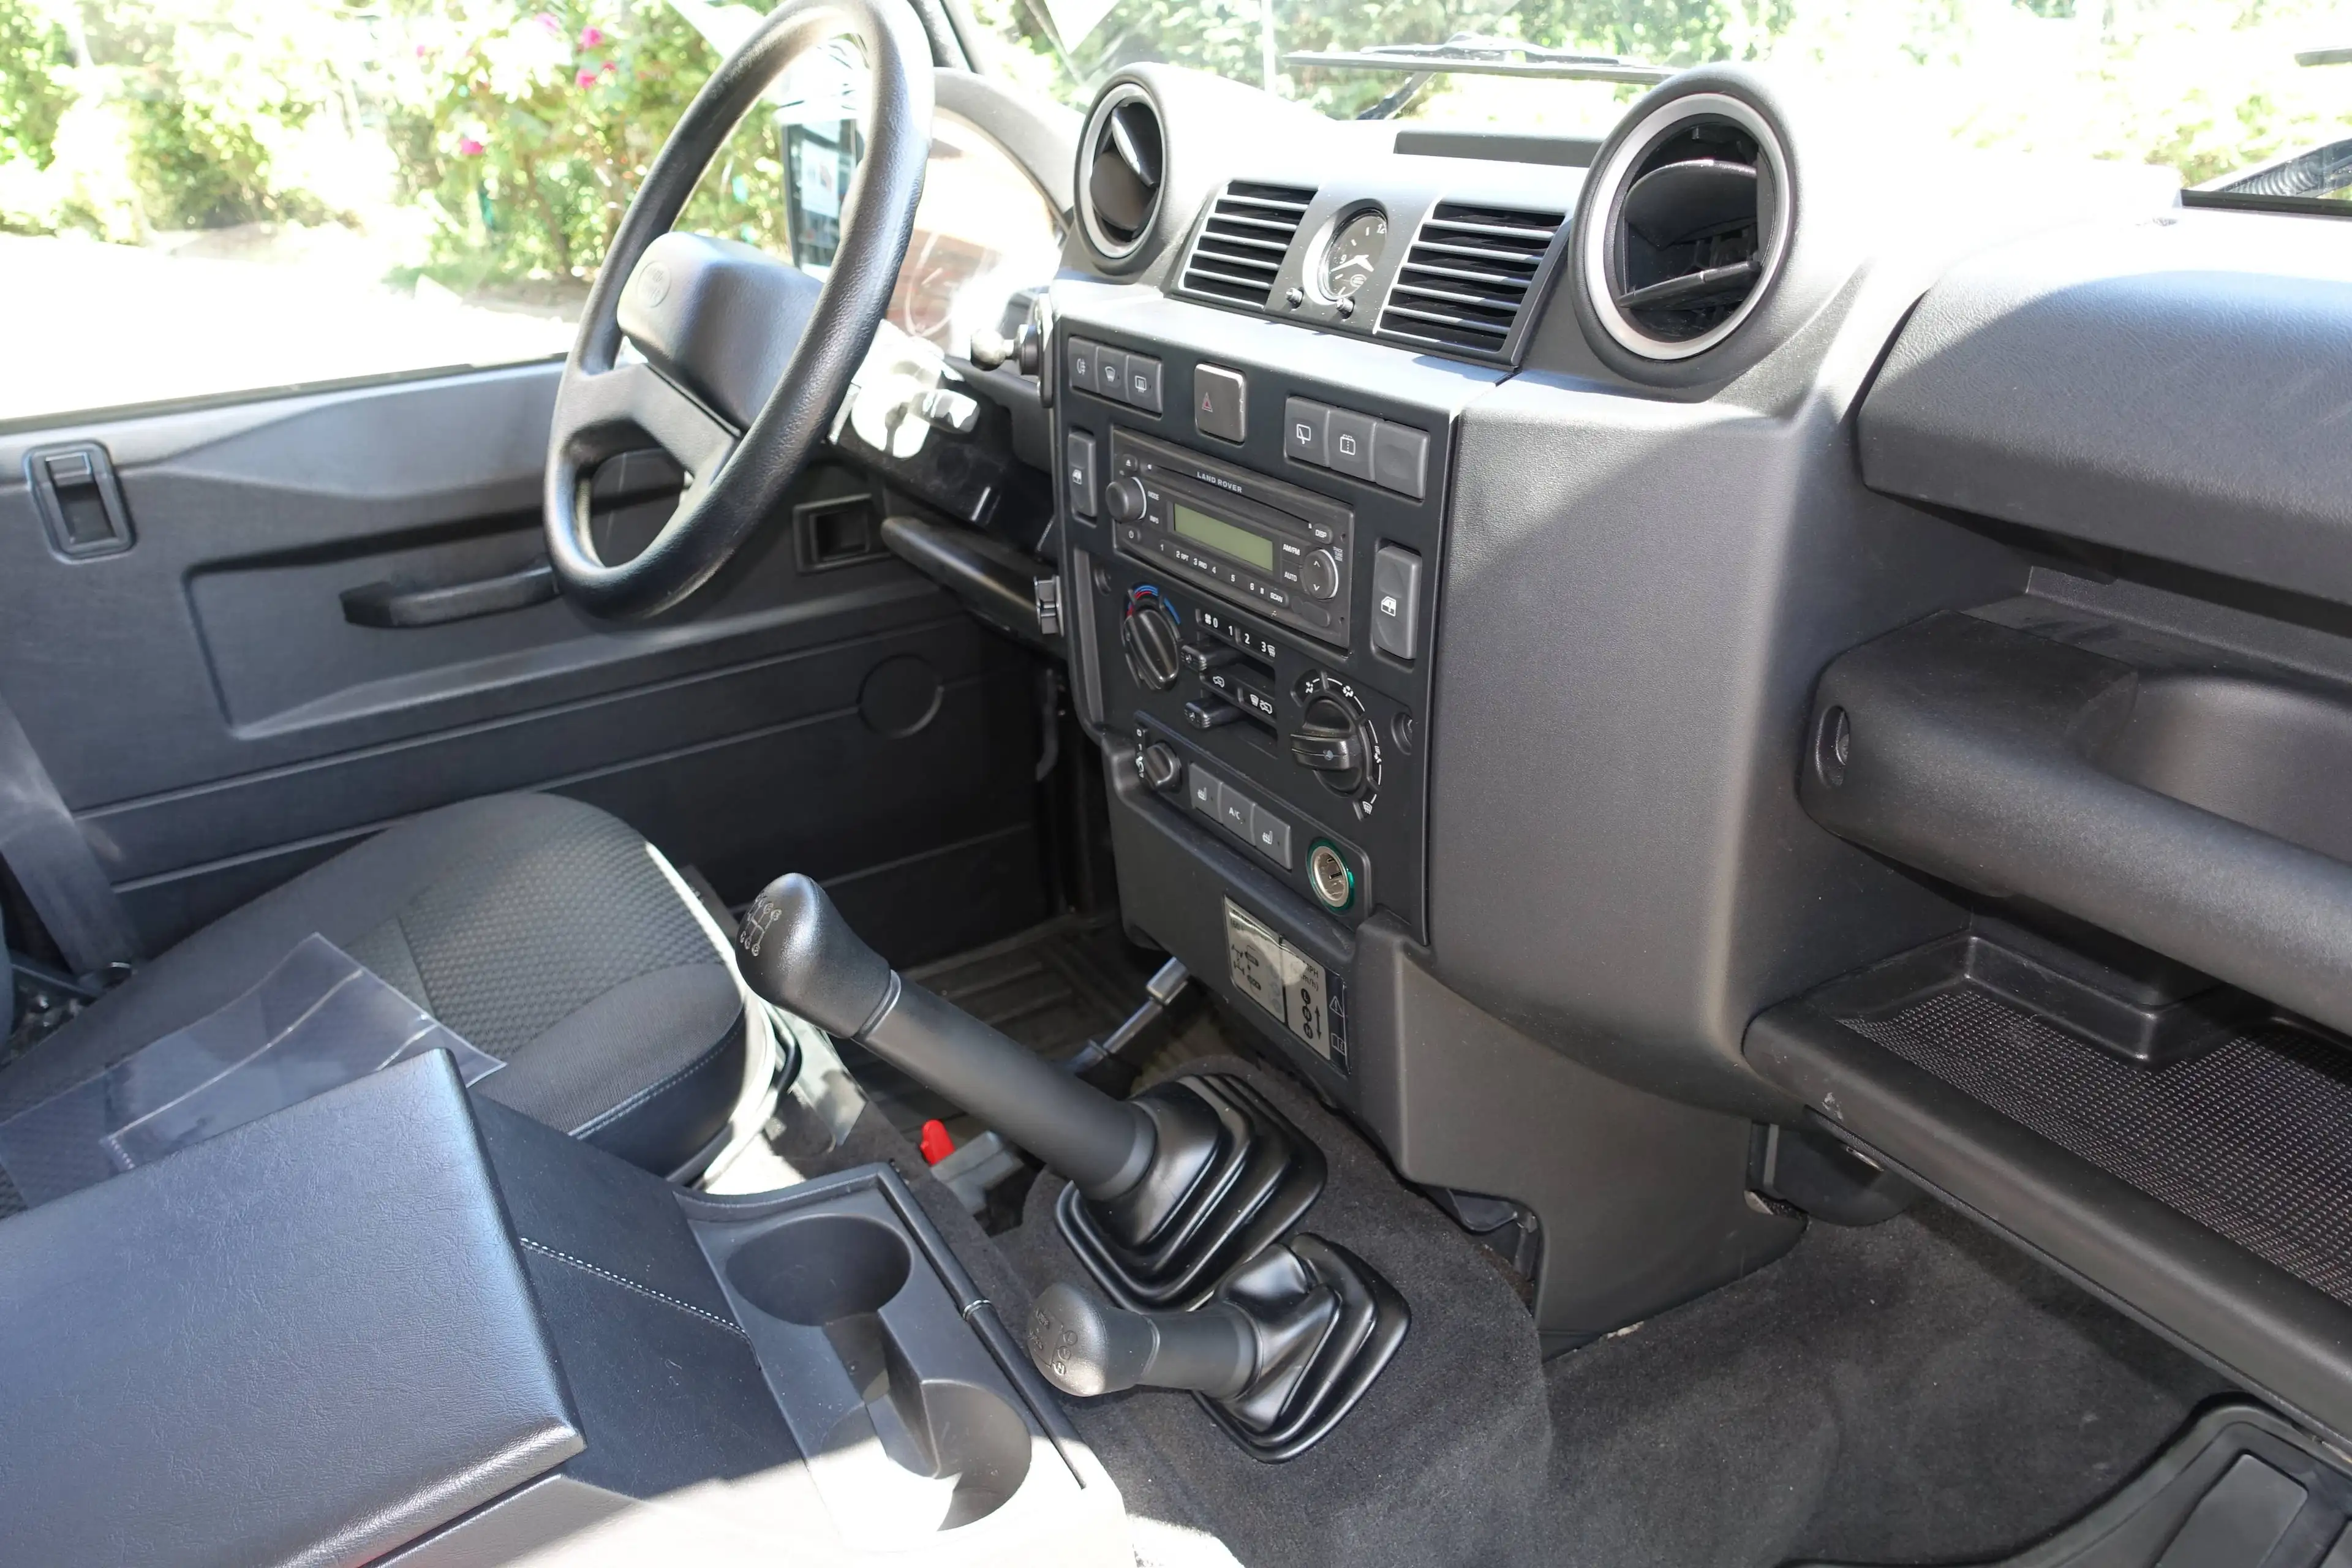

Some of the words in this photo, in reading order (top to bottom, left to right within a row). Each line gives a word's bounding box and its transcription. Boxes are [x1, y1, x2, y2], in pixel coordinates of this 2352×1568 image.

[1340, 254, 1347, 264] 9
[1197, 471, 1216, 483] LAND
[1217, 479, 1242, 493] ROVER
[1148, 491, 1159, 500] MODE
[1315, 529, 1327, 539] DISP
[1283, 544, 1300, 556] AM/FM
[1284, 571, 1298, 582] AUTO
[1231, 574, 1235, 582] 5
[1270, 592, 1283, 603] SCAN
[1213, 617, 1218, 628] 0
[1228, 625, 1233, 636] 1
[1245, 633, 1250, 644] 2
[1261, 641, 1267, 652] 3
[1229, 807, 1241, 821] A/C
